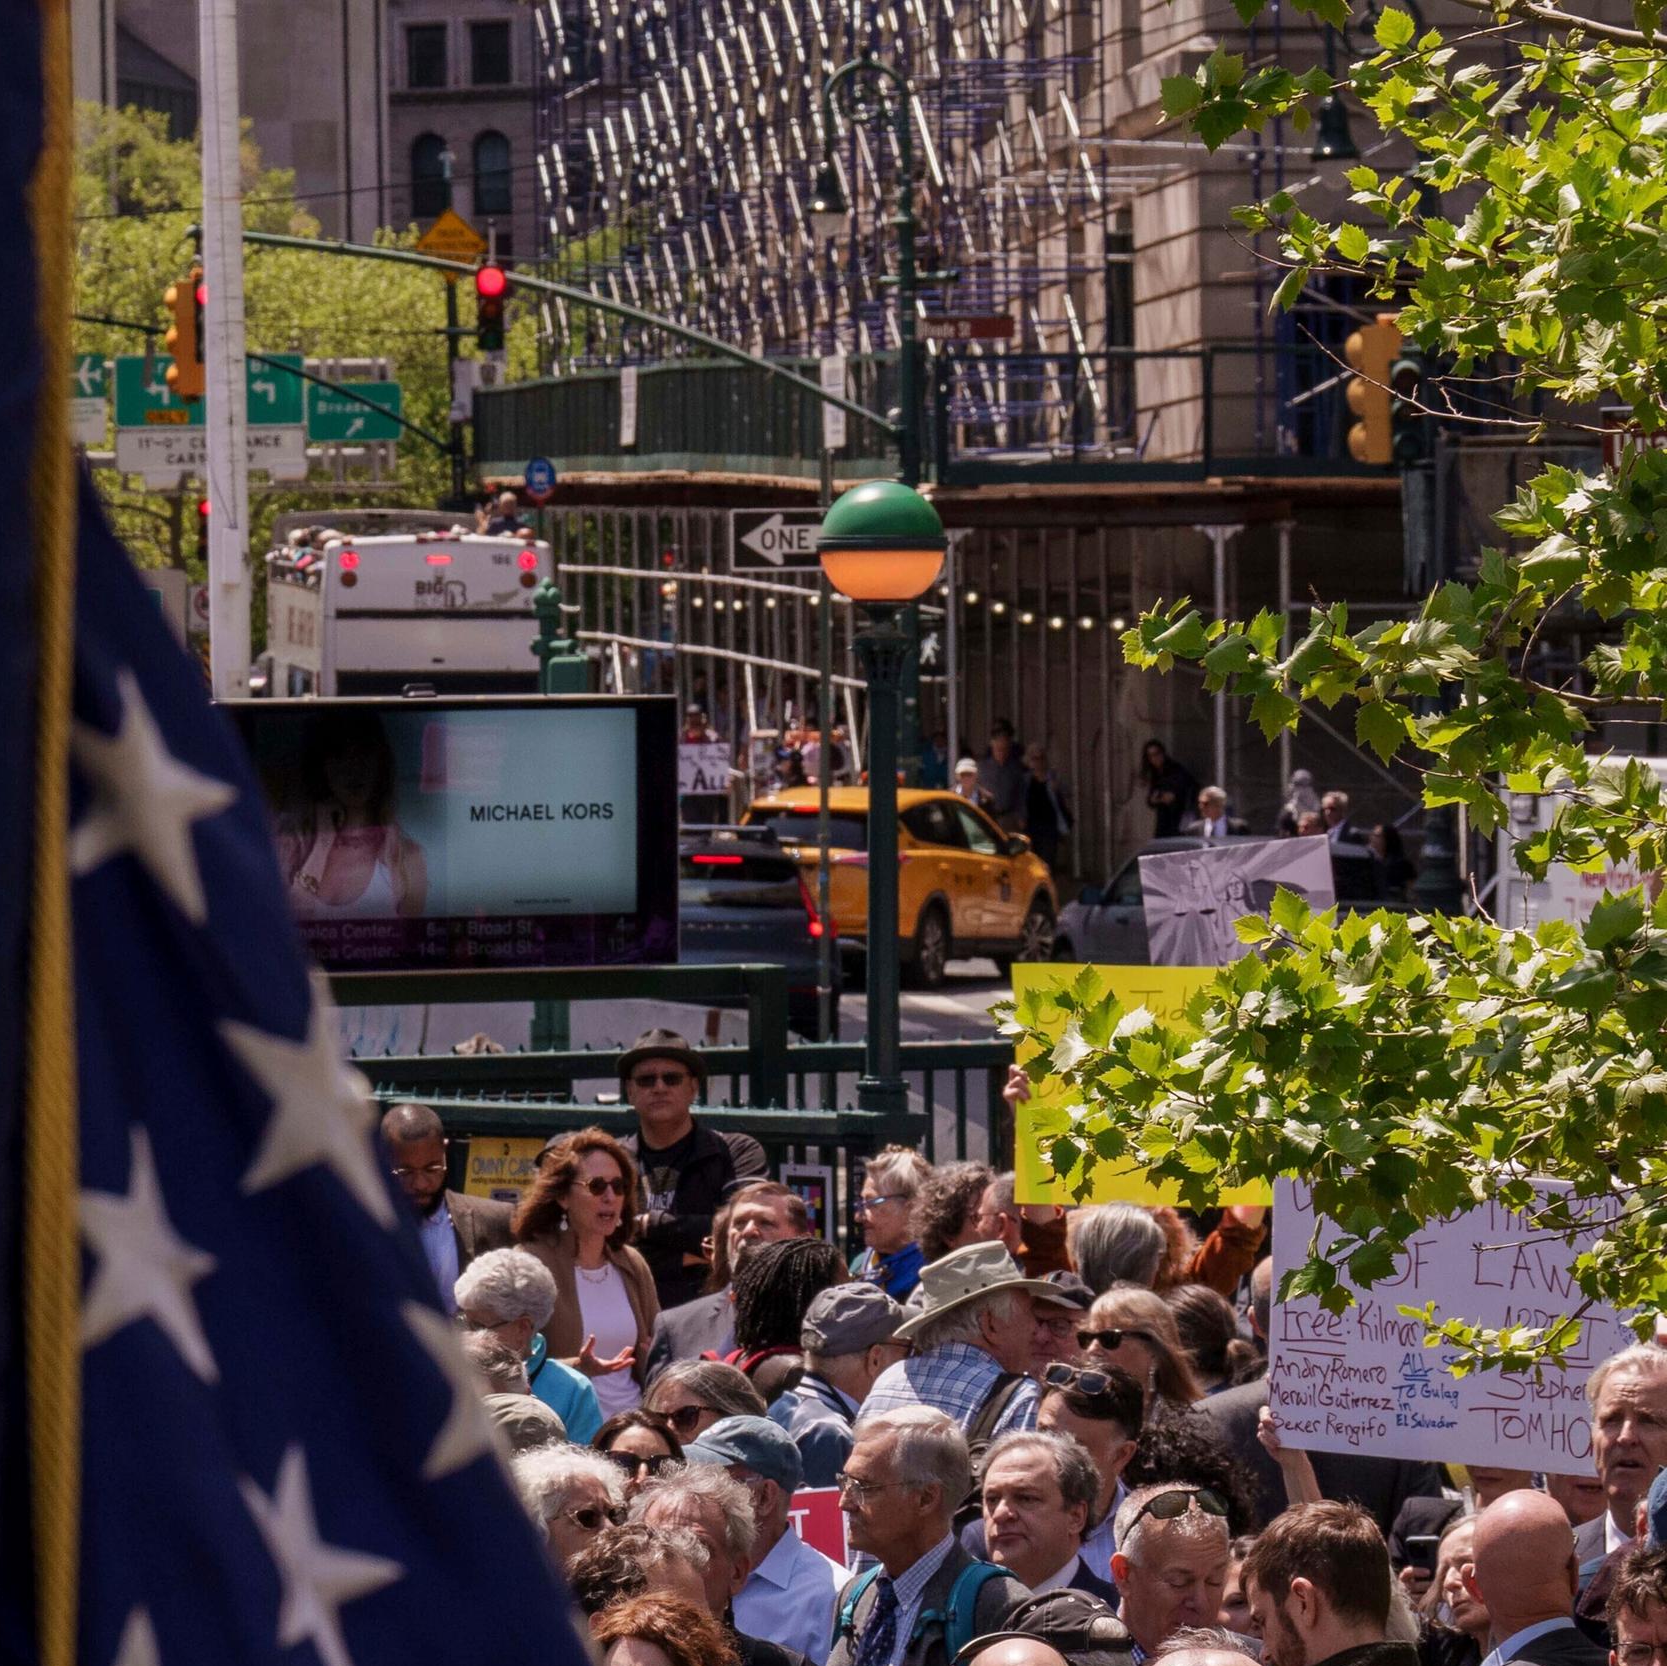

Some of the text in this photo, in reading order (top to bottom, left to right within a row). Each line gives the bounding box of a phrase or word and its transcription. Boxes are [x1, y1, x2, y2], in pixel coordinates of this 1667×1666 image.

[761, 528, 809, 551] ONE
[470, 803, 614, 822] MICHAEL KORS
[1474, 1246, 1574, 1298] LAW
[1357, 1300, 1418, 1348] Kilmar
[1331, 1357, 1387, 1384] Romero
[1398, 1352, 1433, 1375] ALL
[1318, 1386, 1394, 1411] Gutierrez
[1393, 1385, 1459, 1408] TO Gulag
[1398, 1400, 1412, 1412] in
[1326, 1413, 1387, 1446] Rengifo
[1411, 1413, 1457, 1429] Salvador
[1468, 1407, 1547, 1444] TOM
